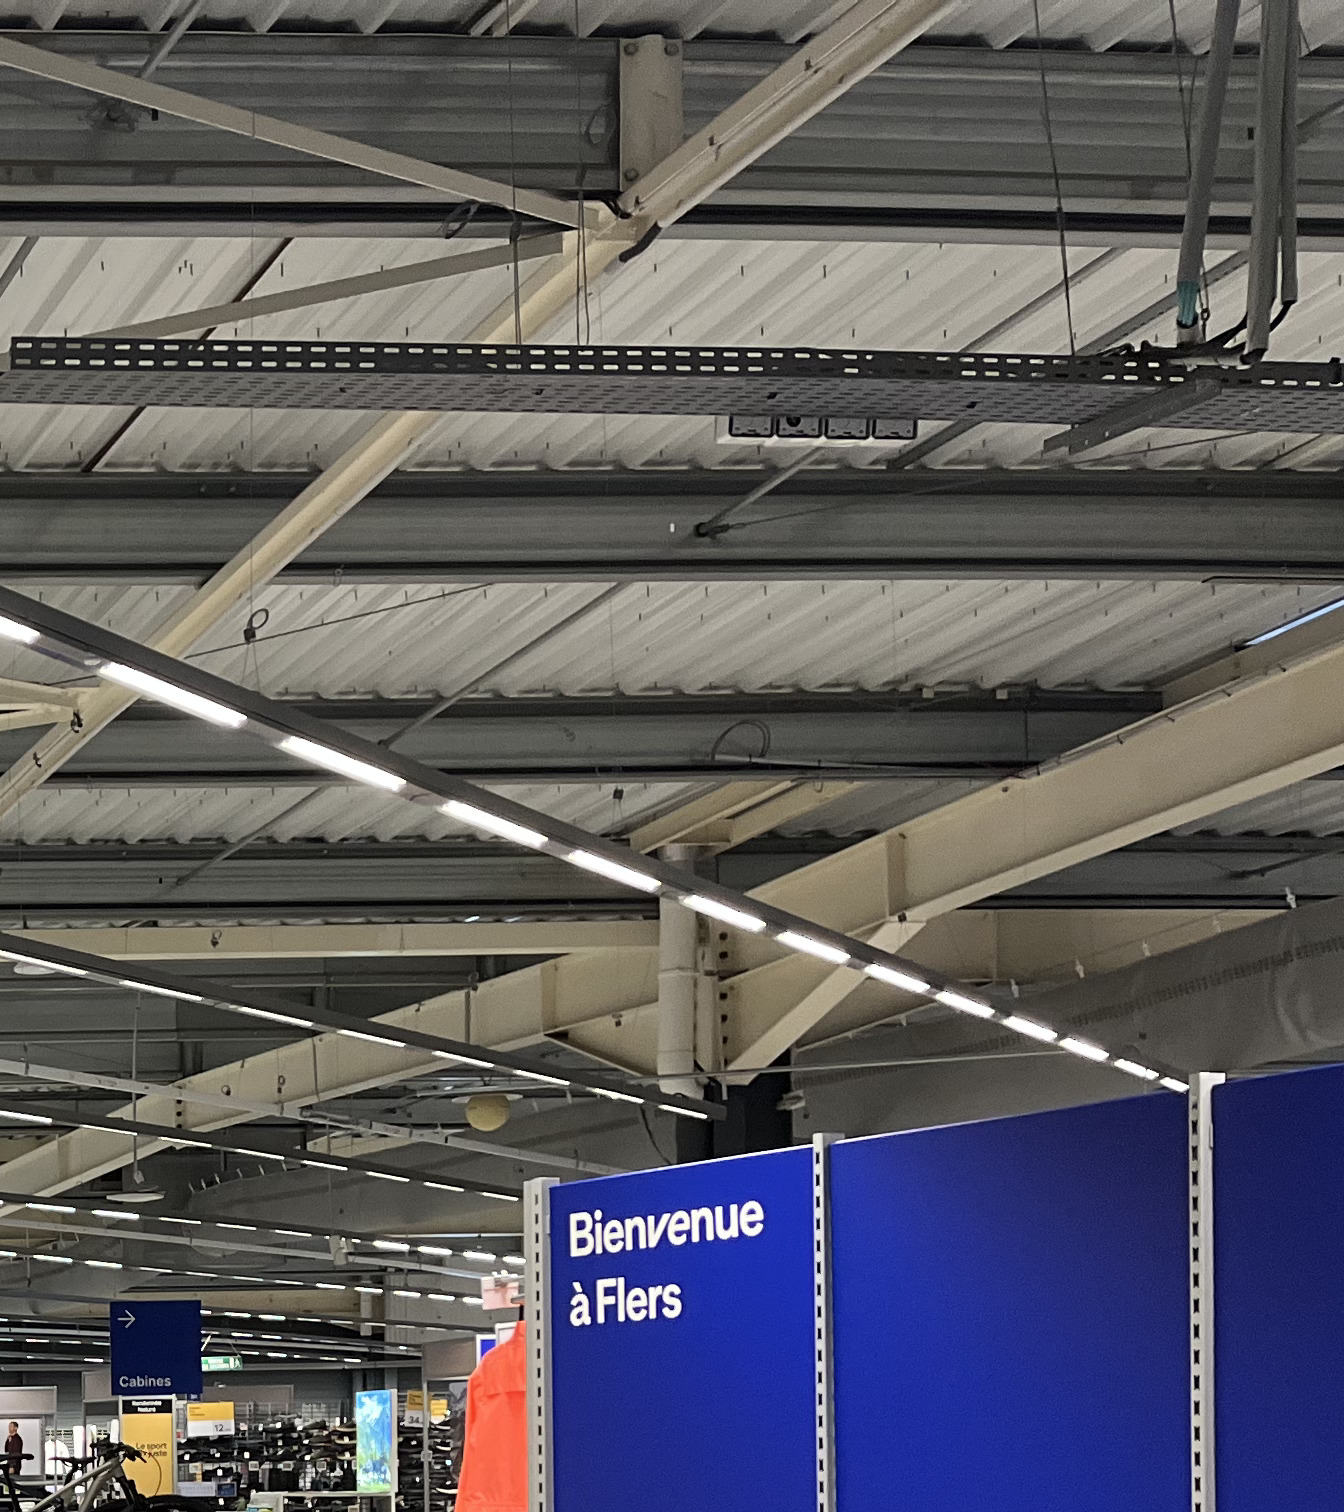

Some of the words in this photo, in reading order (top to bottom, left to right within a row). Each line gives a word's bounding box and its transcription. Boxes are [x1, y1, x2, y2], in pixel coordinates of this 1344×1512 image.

[569, 1199, 765, 1258] Bienvenue
[569, 1281, 591, 1327] à
[595, 1276, 683, 1325] Flers
[118, 1375, 172, 1388] Cabines
[147, 1442, 168, 1451] sport
